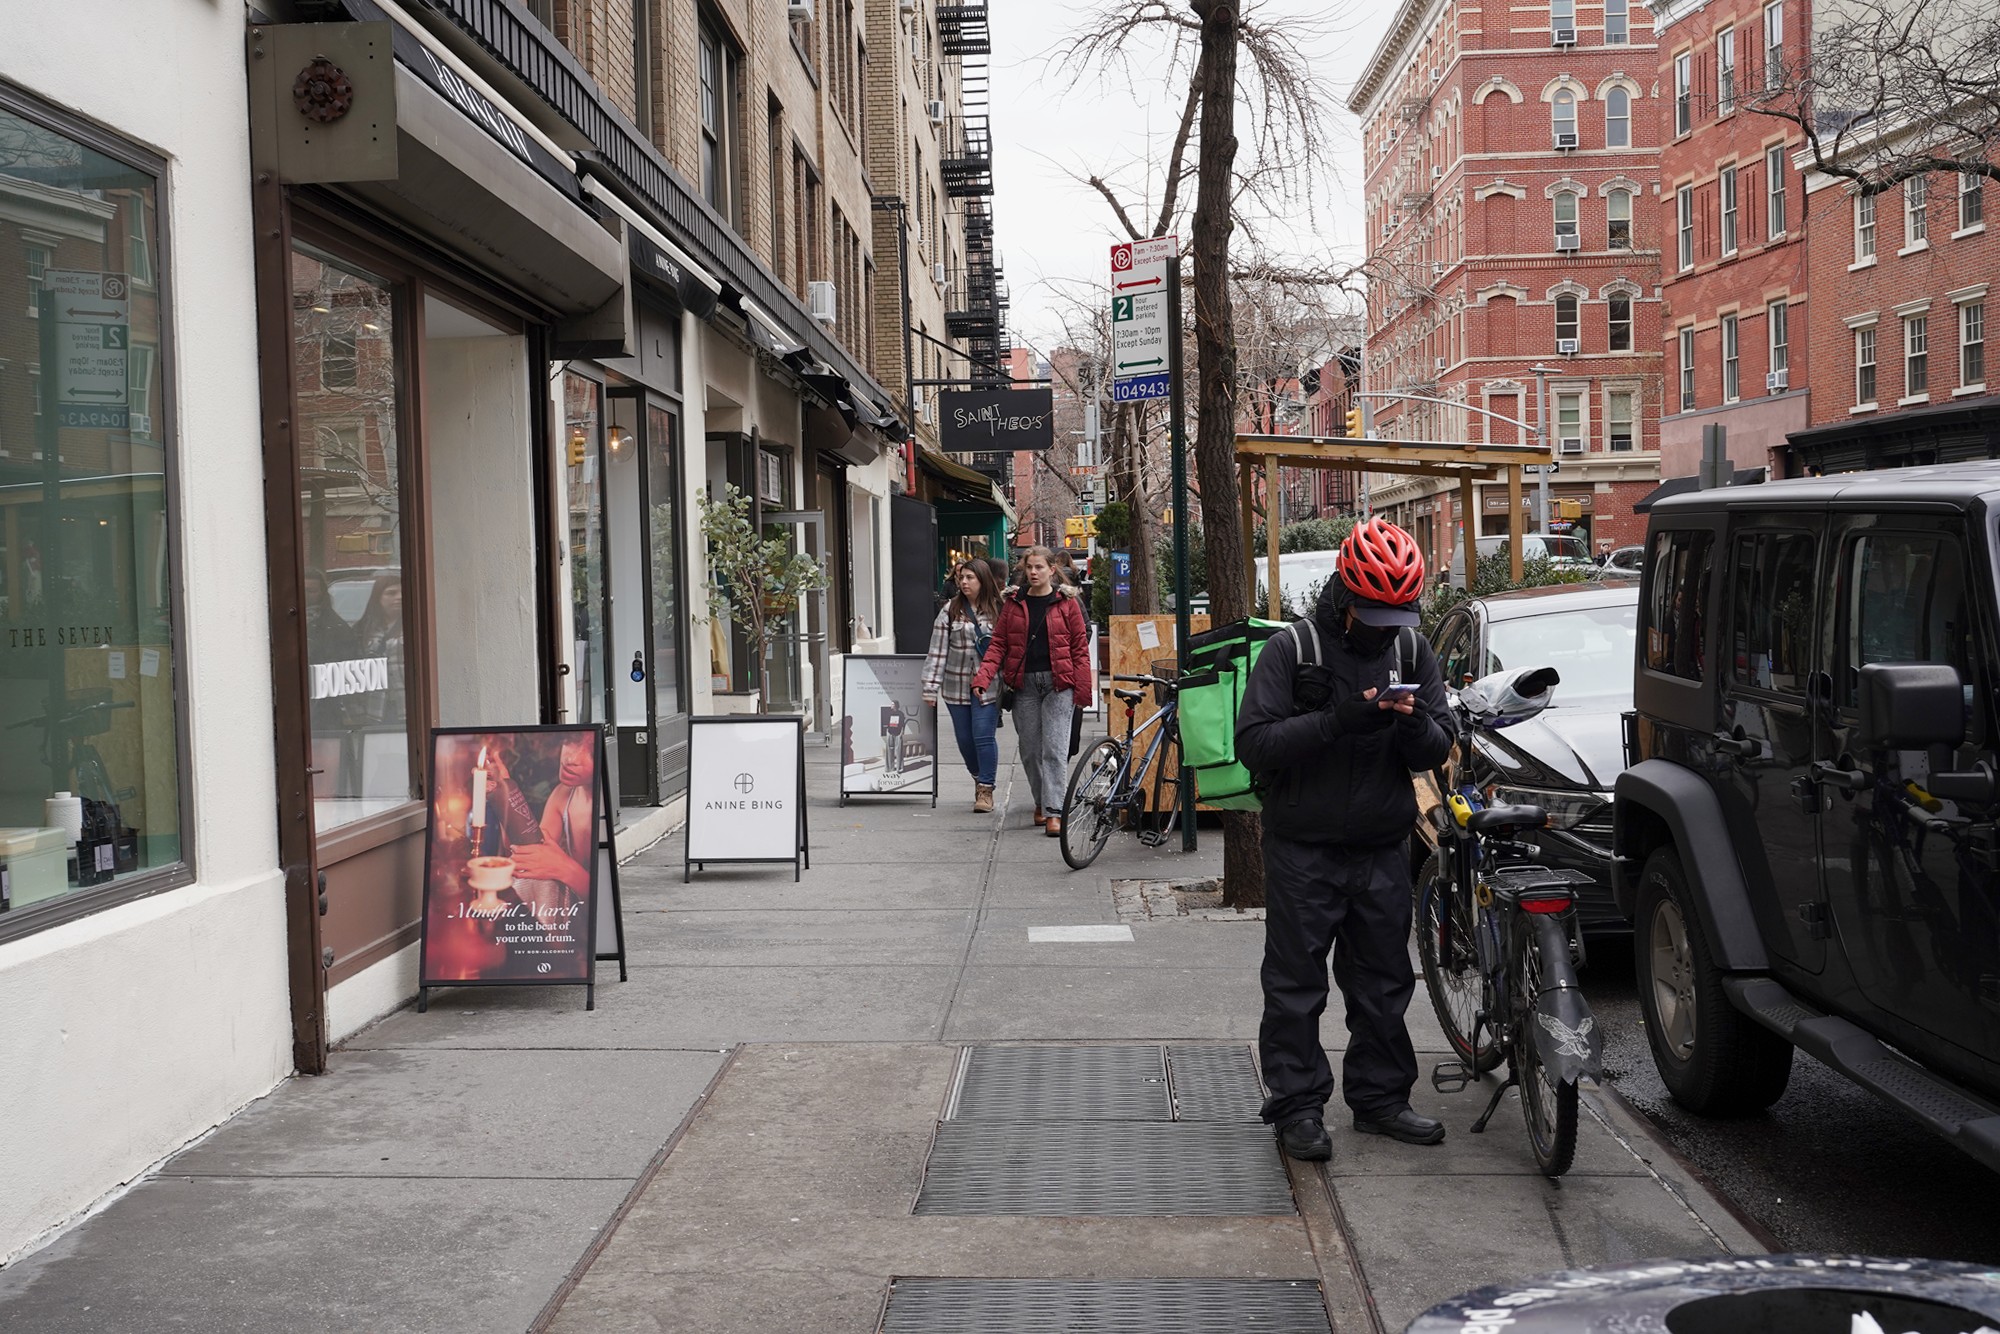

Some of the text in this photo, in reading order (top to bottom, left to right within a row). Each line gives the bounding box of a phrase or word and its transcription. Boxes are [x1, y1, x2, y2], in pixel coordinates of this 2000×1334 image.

[1134, 257, 1152, 266] Except
[1135, 296, 1148, 305] hour
[1117, 298, 1129, 320] 2
[1135, 303, 1158, 314] metered
[1135, 311, 1156, 321] parking
[1116, 328, 1139, 339] 7:30am
[1144, 326, 1161, 338] 10pm
[1116, 336, 1163, 350] Except Sunday
[9, 626, 113, 648] THE SEVEN
[309, 657, 388, 699] BOISSON
[705, 800, 783, 810] ANINE BING
[447, 901, 585, 922] Mindful March
[505, 921, 571, 932] to the beat of
[495, 933, 576, 945] your own drum.
